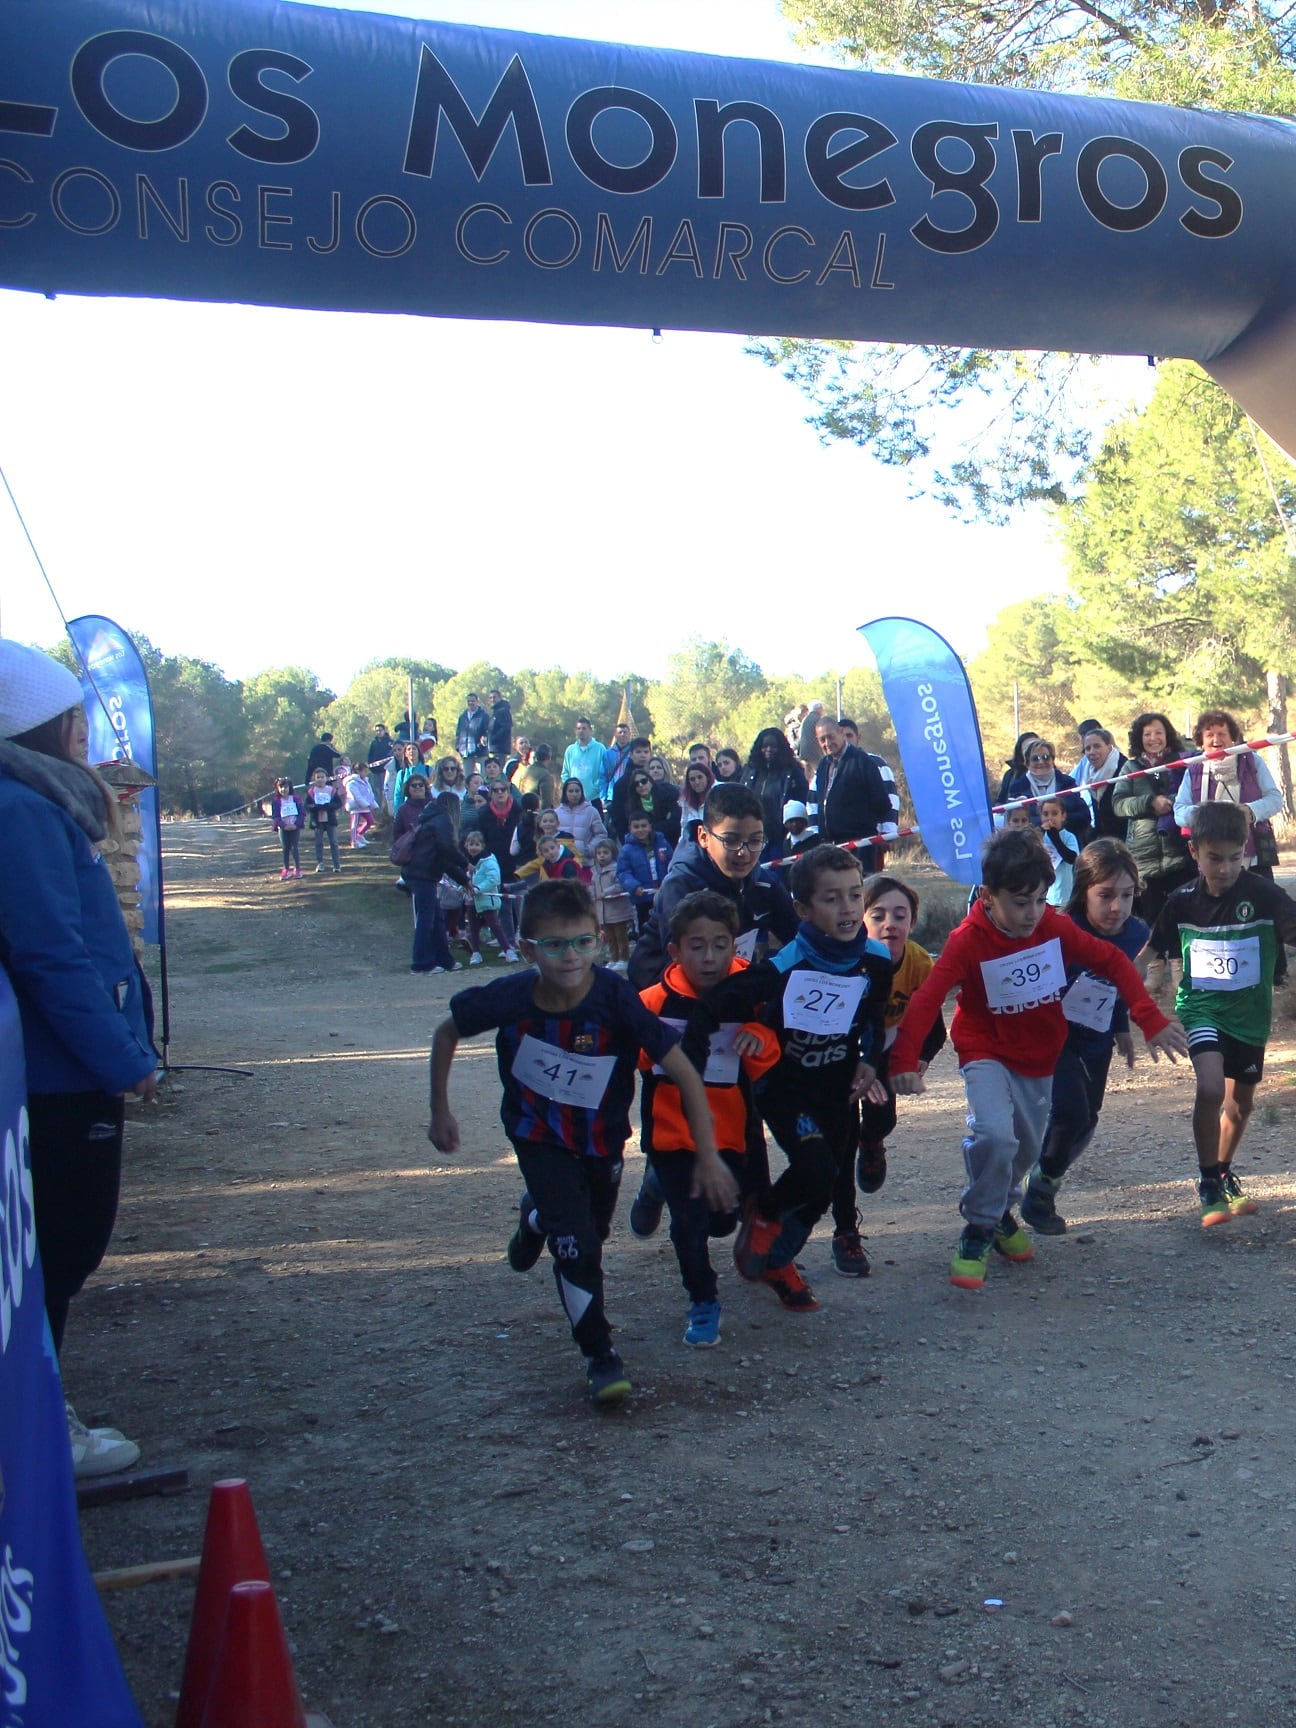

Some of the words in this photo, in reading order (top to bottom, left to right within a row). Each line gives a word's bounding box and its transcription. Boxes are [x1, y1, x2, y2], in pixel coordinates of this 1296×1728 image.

[403, 42, 1243, 255] Monegros
[0, 158, 417, 258] CONSEJO
[455, 202, 895, 290] COMARCAL
[1011, 963, 1041, 987] 39
[1213, 957, 1239, 975] 30
[802, 989, 841, 1014] 27
[542, 1063, 579, 1087] 41
[557, 1243, 579, 1260] 66
